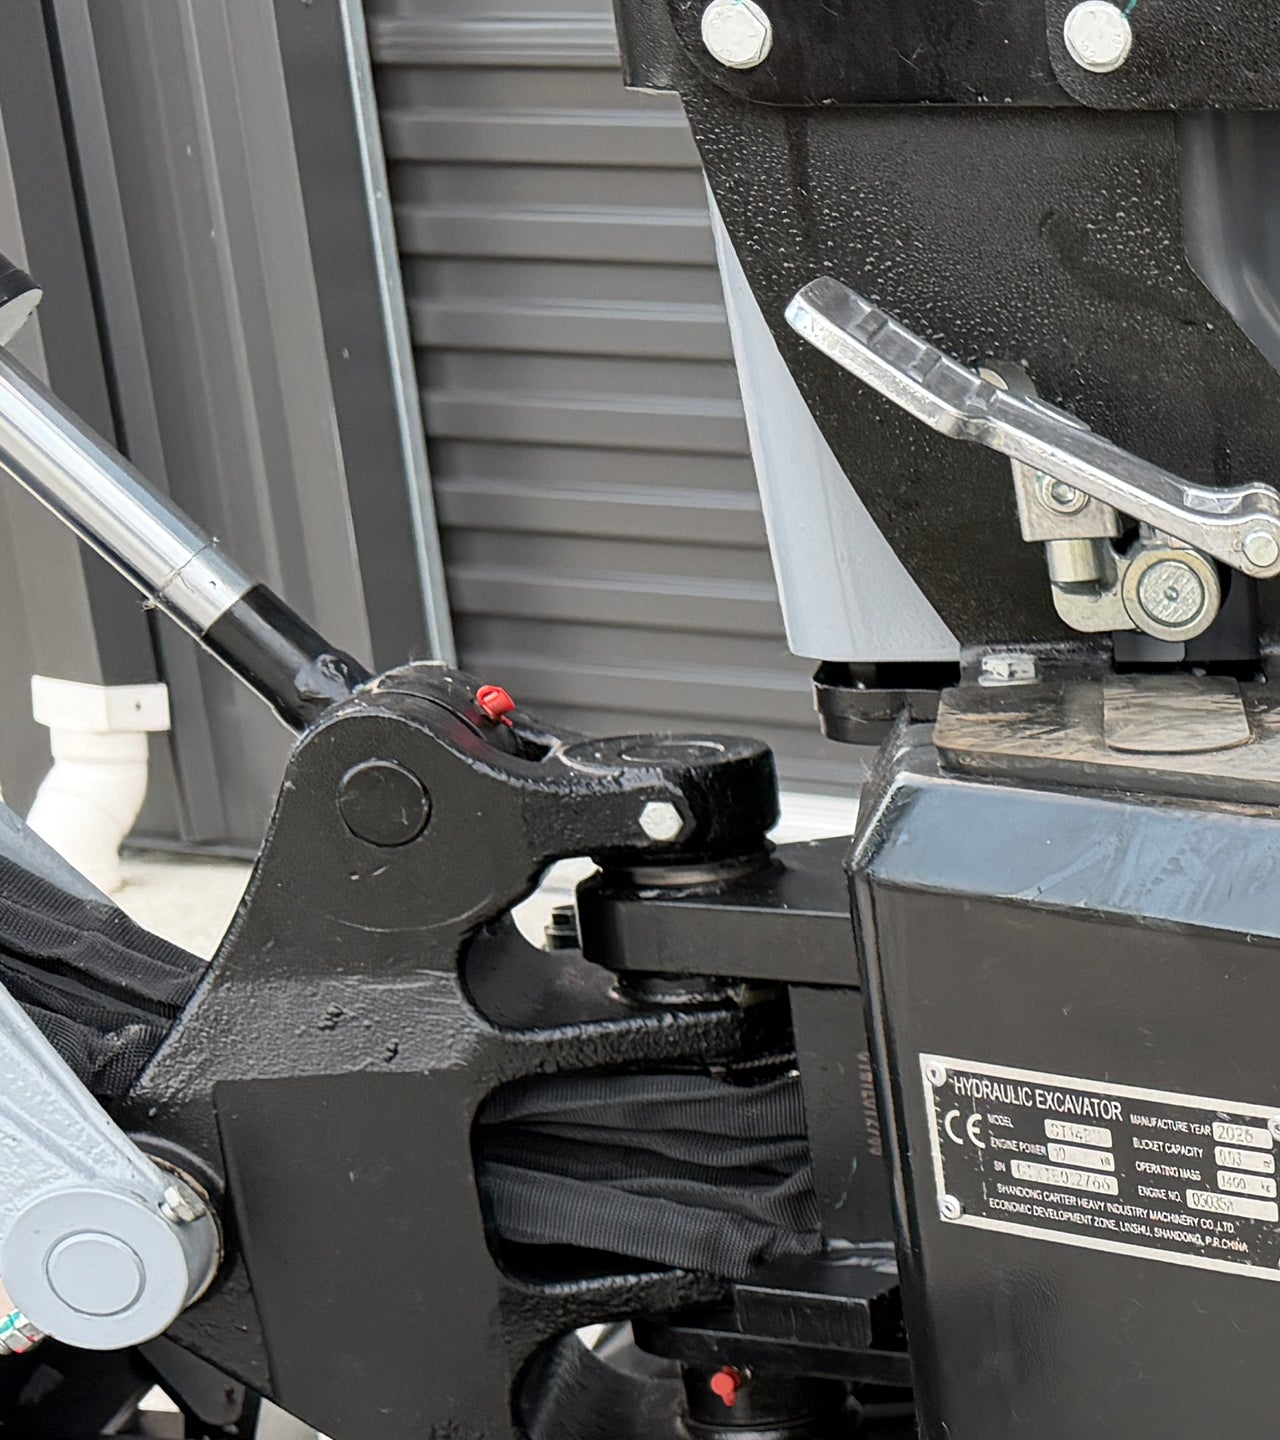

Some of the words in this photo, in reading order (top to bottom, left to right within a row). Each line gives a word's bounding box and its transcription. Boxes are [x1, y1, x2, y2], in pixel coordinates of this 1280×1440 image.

[954, 1075, 1033, 1107] HYDRAULIC
[1036, 1089, 1124, 1122] EXCAVATOR
[944, 1109, 986, 1149] CE
[987, 1113, 1014, 1129] MODEL
[1130, 1113, 1189, 1133] MANUFACTURE
[1189, 1123, 1213, 1137] YEAR
[990, 1136, 1019, 1152] ENGINE
[1019, 1142, 1047, 1156] POWER
[1132, 1137, 1164, 1153] BUCKET
[1164, 1143, 1204, 1159] CAPACITY
[1135, 1160, 1179, 1178] OPERATING
[1138, 1184, 1168, 1200] ENGINE
[988, 1197, 1033, 1216] ECONOMIC
[1032, 1205, 1094, 1226] DEVELOPMENT
[996, 1182, 1043, 1201] SHANDONG
[1042, 1191, 1077, 1207] CARTER
[1077, 1197, 1105, 1212] HEAVY
[1106, 1201, 1148, 1219] INDUSTRY
[1149, 1210, 1200, 1229] MACHINERY
